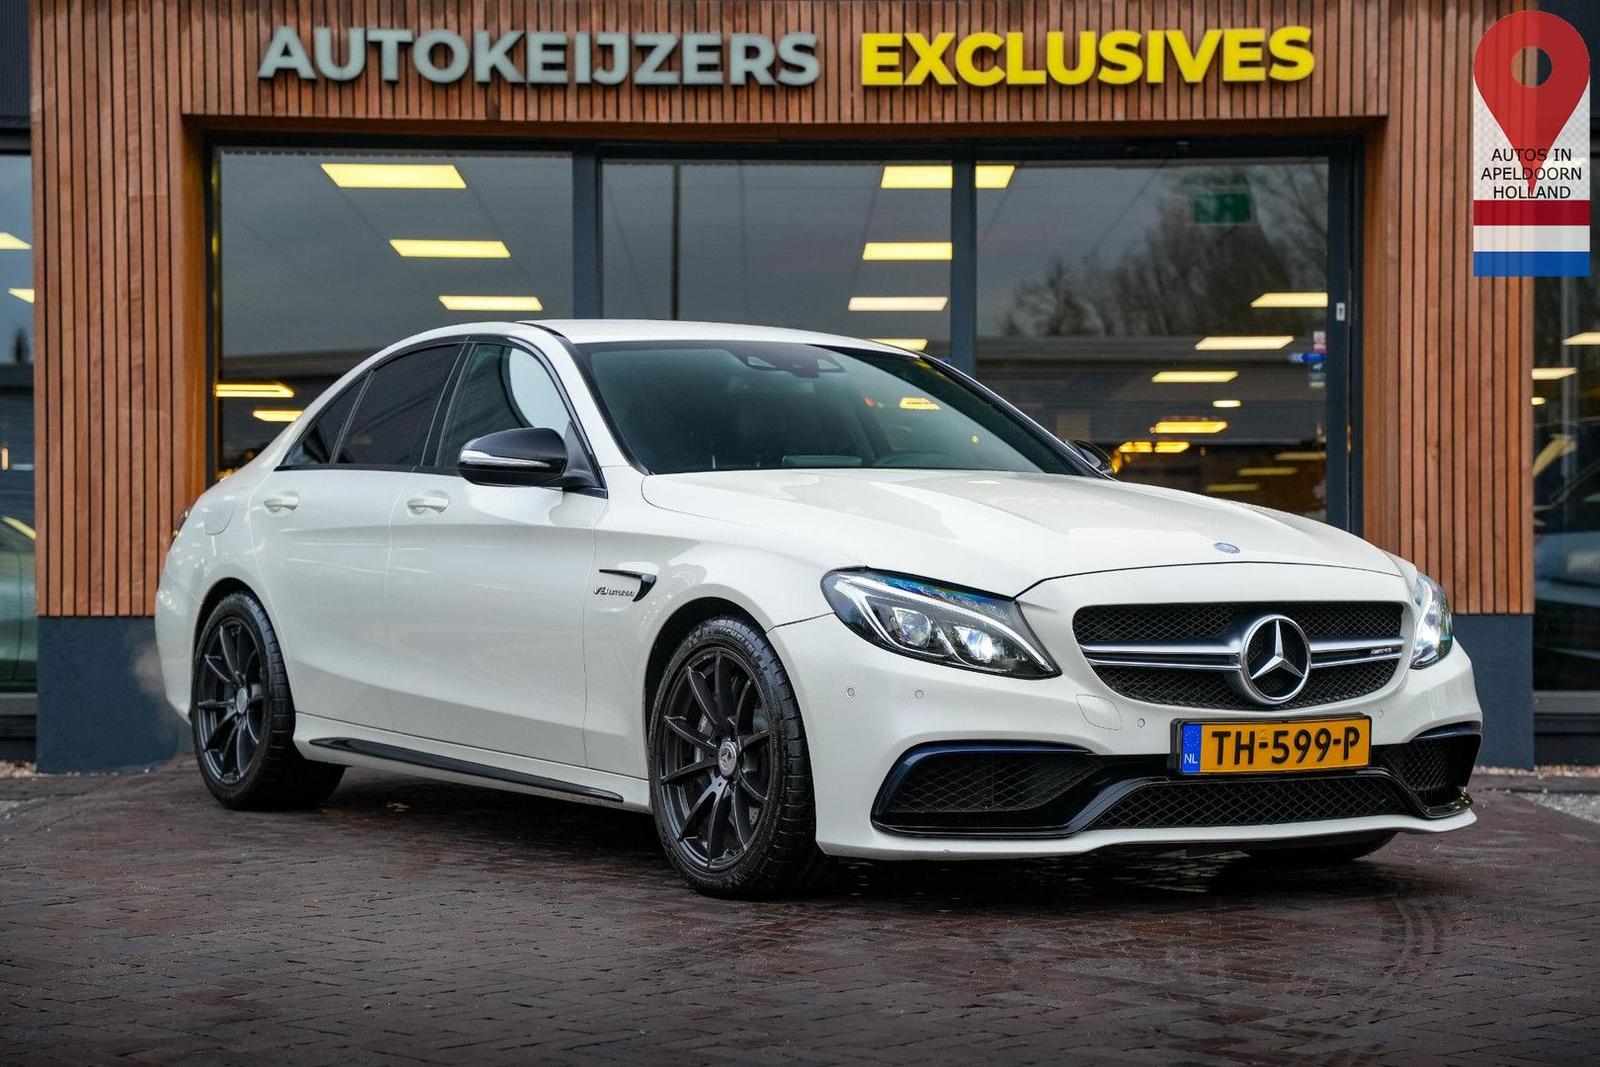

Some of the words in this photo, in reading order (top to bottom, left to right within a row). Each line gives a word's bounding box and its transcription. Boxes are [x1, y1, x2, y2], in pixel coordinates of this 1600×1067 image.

[257, 25, 821, 86] AUTOKEIJZERS
[861, 25, 1315, 87] EXCLUSIVES
[1184, 753, 1198, 764] NL
[1211, 726, 1360, 766] TH-599-P
